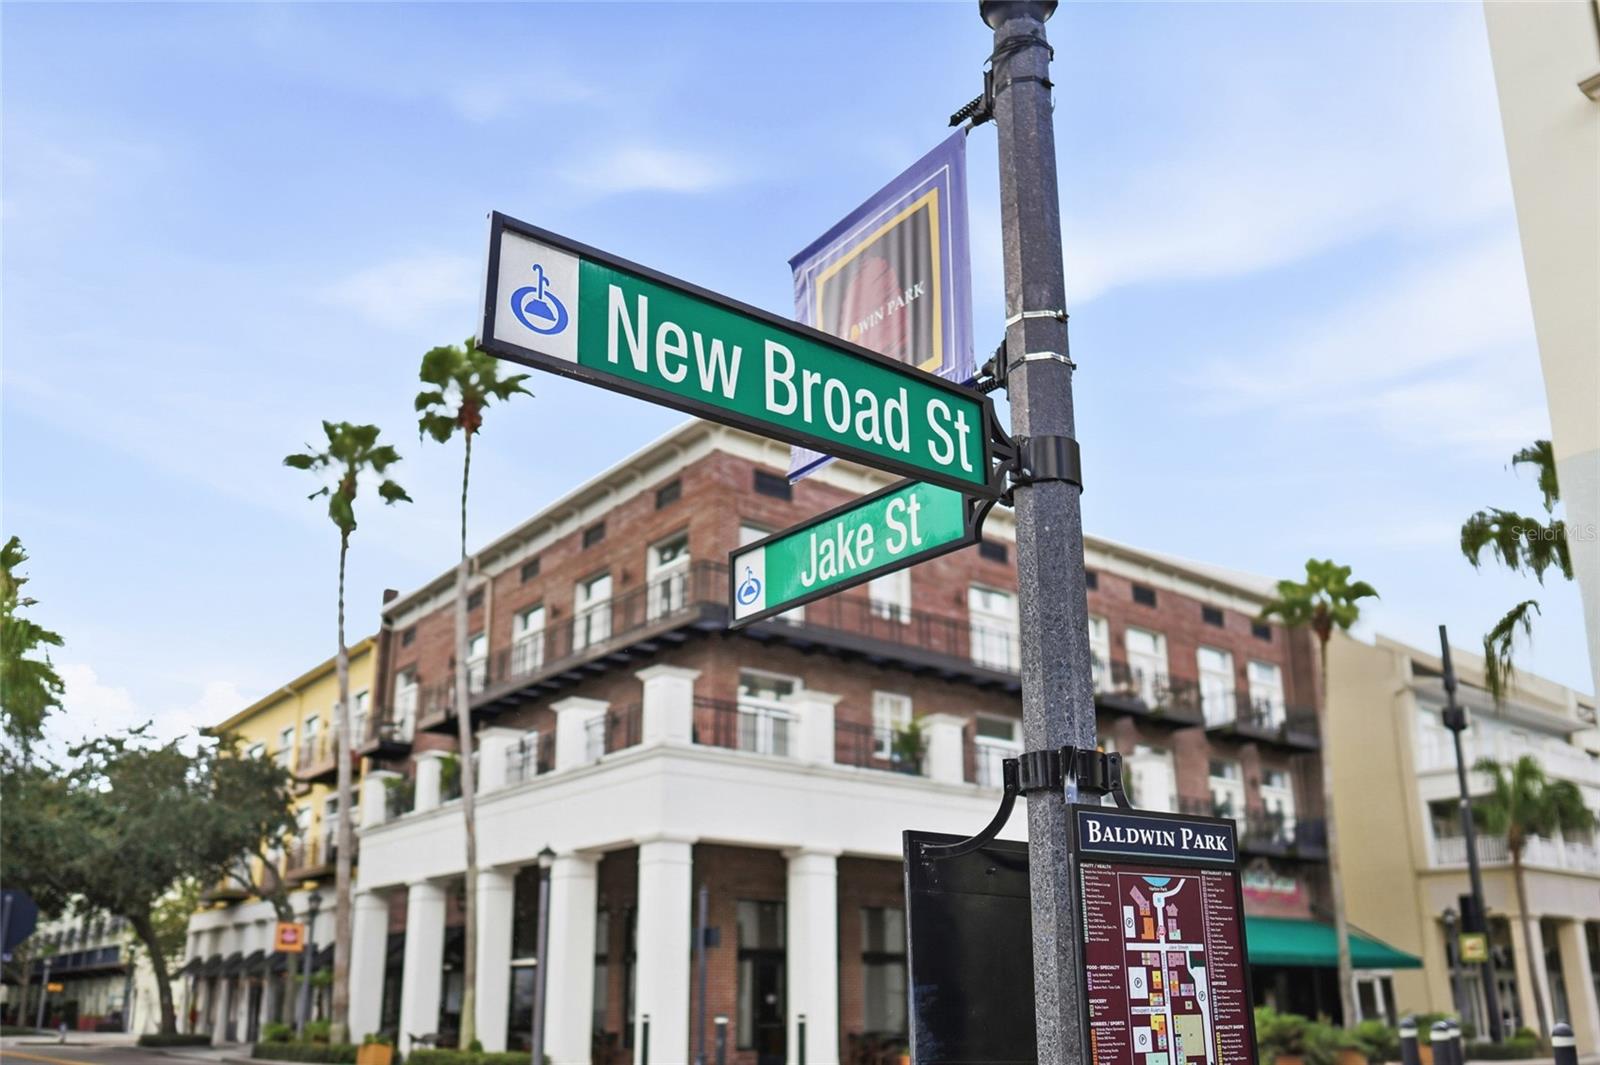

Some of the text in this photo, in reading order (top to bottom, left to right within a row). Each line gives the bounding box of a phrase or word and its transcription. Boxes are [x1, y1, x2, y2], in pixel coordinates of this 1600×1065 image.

[887, 281, 924, 316] PARK
[607, 283, 973, 473] New Broad St
[801, 493, 922, 588] Jake St
[1086, 819, 1228, 851] BALDWIN PARK
